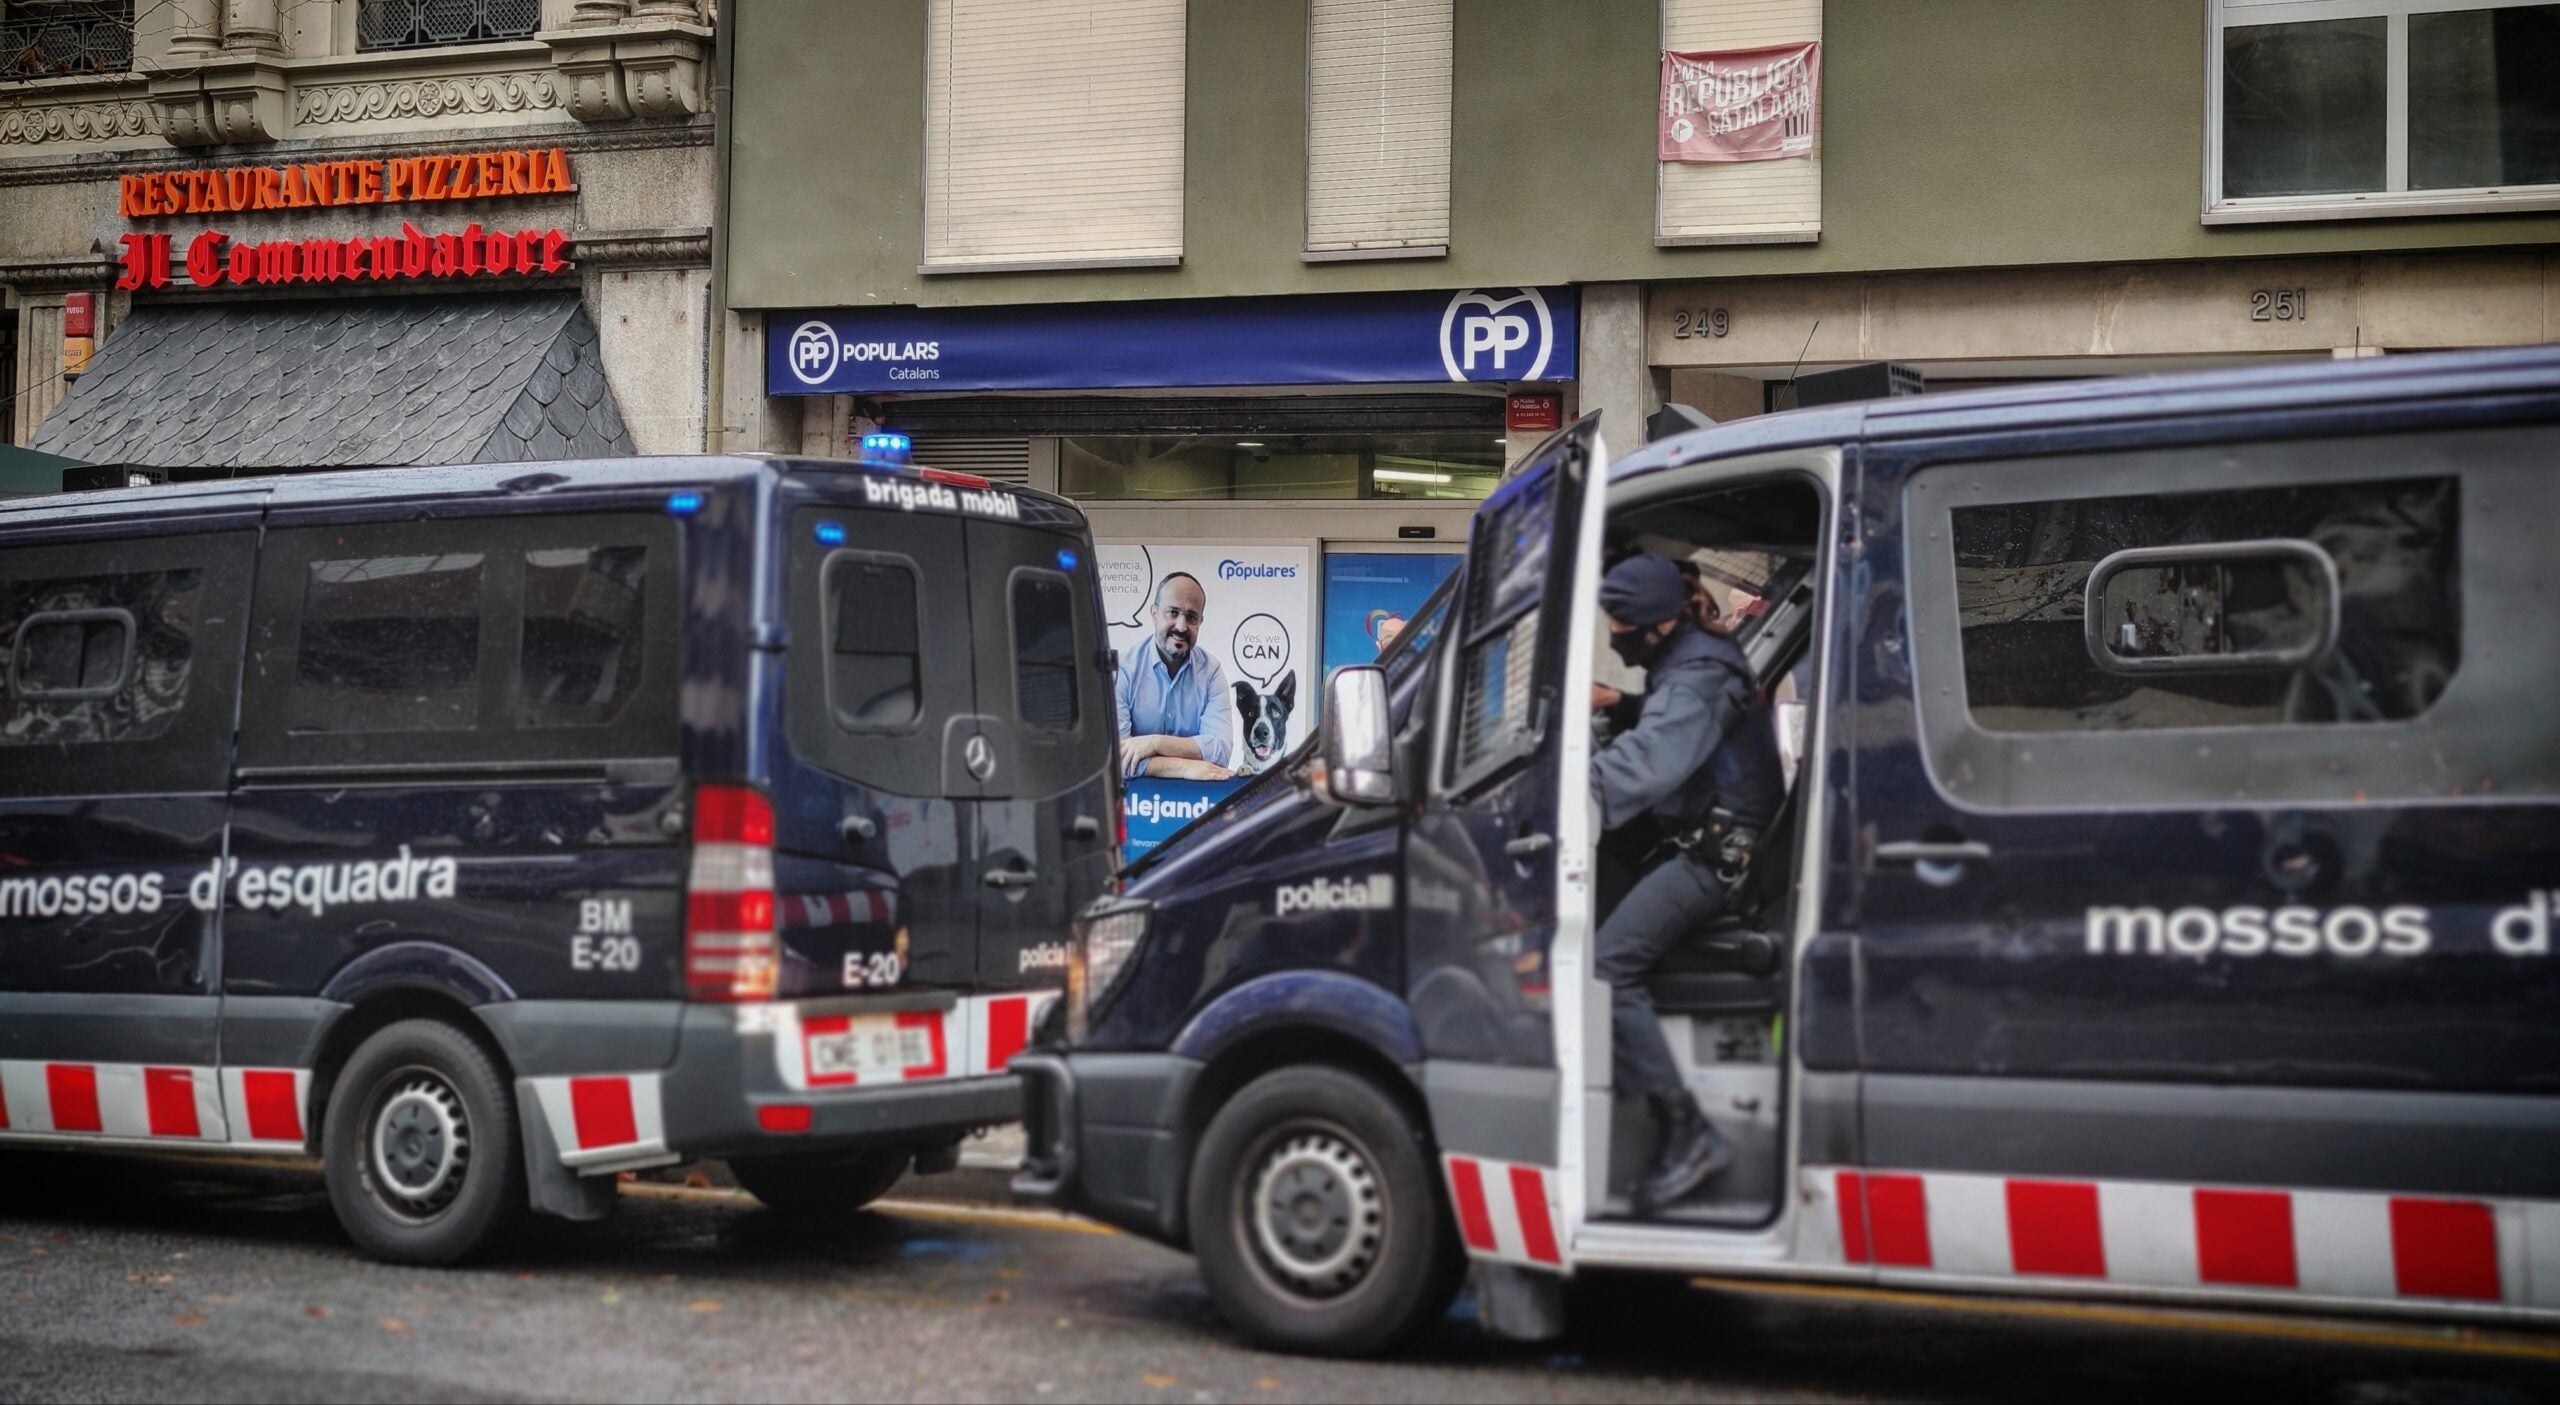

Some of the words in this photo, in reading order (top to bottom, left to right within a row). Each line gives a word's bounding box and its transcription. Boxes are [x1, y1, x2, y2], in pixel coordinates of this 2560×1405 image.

[119, 160, 383, 218] RESTAURANTE
[388, 148, 574, 201] PIZZERIA
[186, 222, 572, 287] Commendatore
[2252, 290, 2306, 321] 251
[1674, 310, 1730, 338] 249
[800, 342, 829, 369] PP
[843, 341, 940, 362] POPULARS
[1464, 316, 1530, 370] PP
[889, 367, 940, 381] Catalans
[863, 476, 957, 510] brigada
[1226, 563, 1296, 580] populares
[1242, 644, 1281, 659] CAN
[1243, 633, 1263, 643] Yes,
[1265, 635, 1281, 643] we
[1123, 793, 1216, 824] lejand
[0, 870, 163, 917] mossos
[579, 901, 631, 932] BM
[2085, 905, 2432, 956] mossos
[570, 937, 639, 970] E-20
[842, 952, 901, 987] E-20
